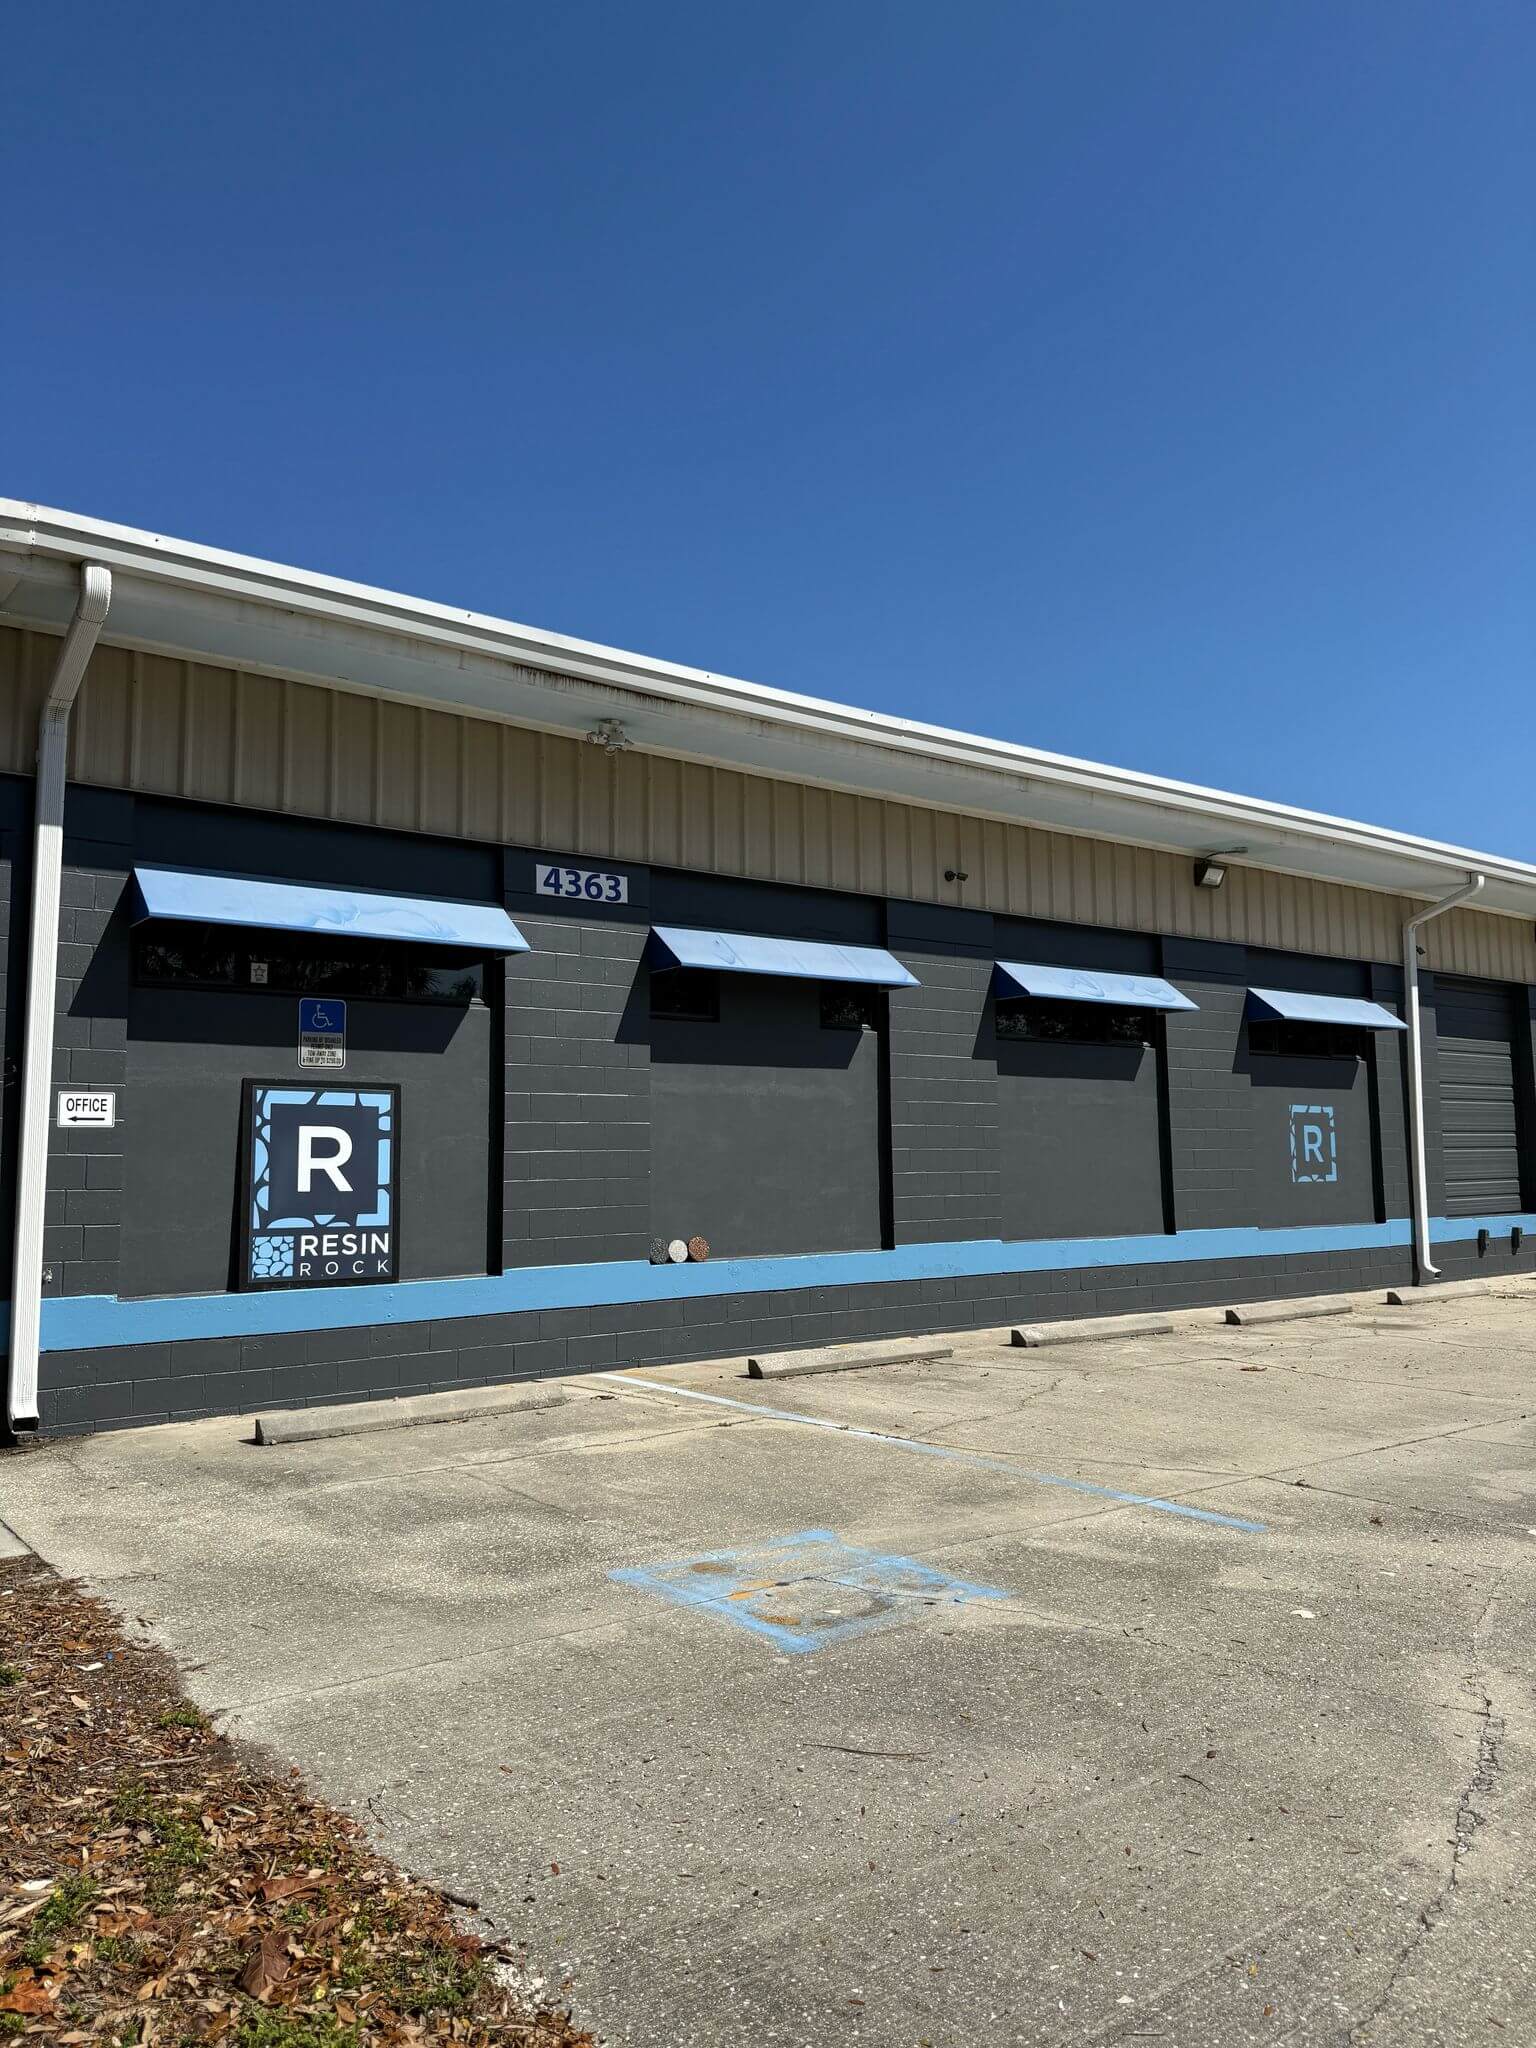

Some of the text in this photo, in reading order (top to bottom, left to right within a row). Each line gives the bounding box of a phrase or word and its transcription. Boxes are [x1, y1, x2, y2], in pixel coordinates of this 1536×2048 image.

[543, 868, 622, 902] 4363
[66, 1098, 107, 1112] OFFICE
[297, 1125, 354, 1192] R
[1303, 1125, 1324, 1163] R
[300, 1233, 389, 1257] RESIN
[299, 1259, 389, 1277] ROCK
